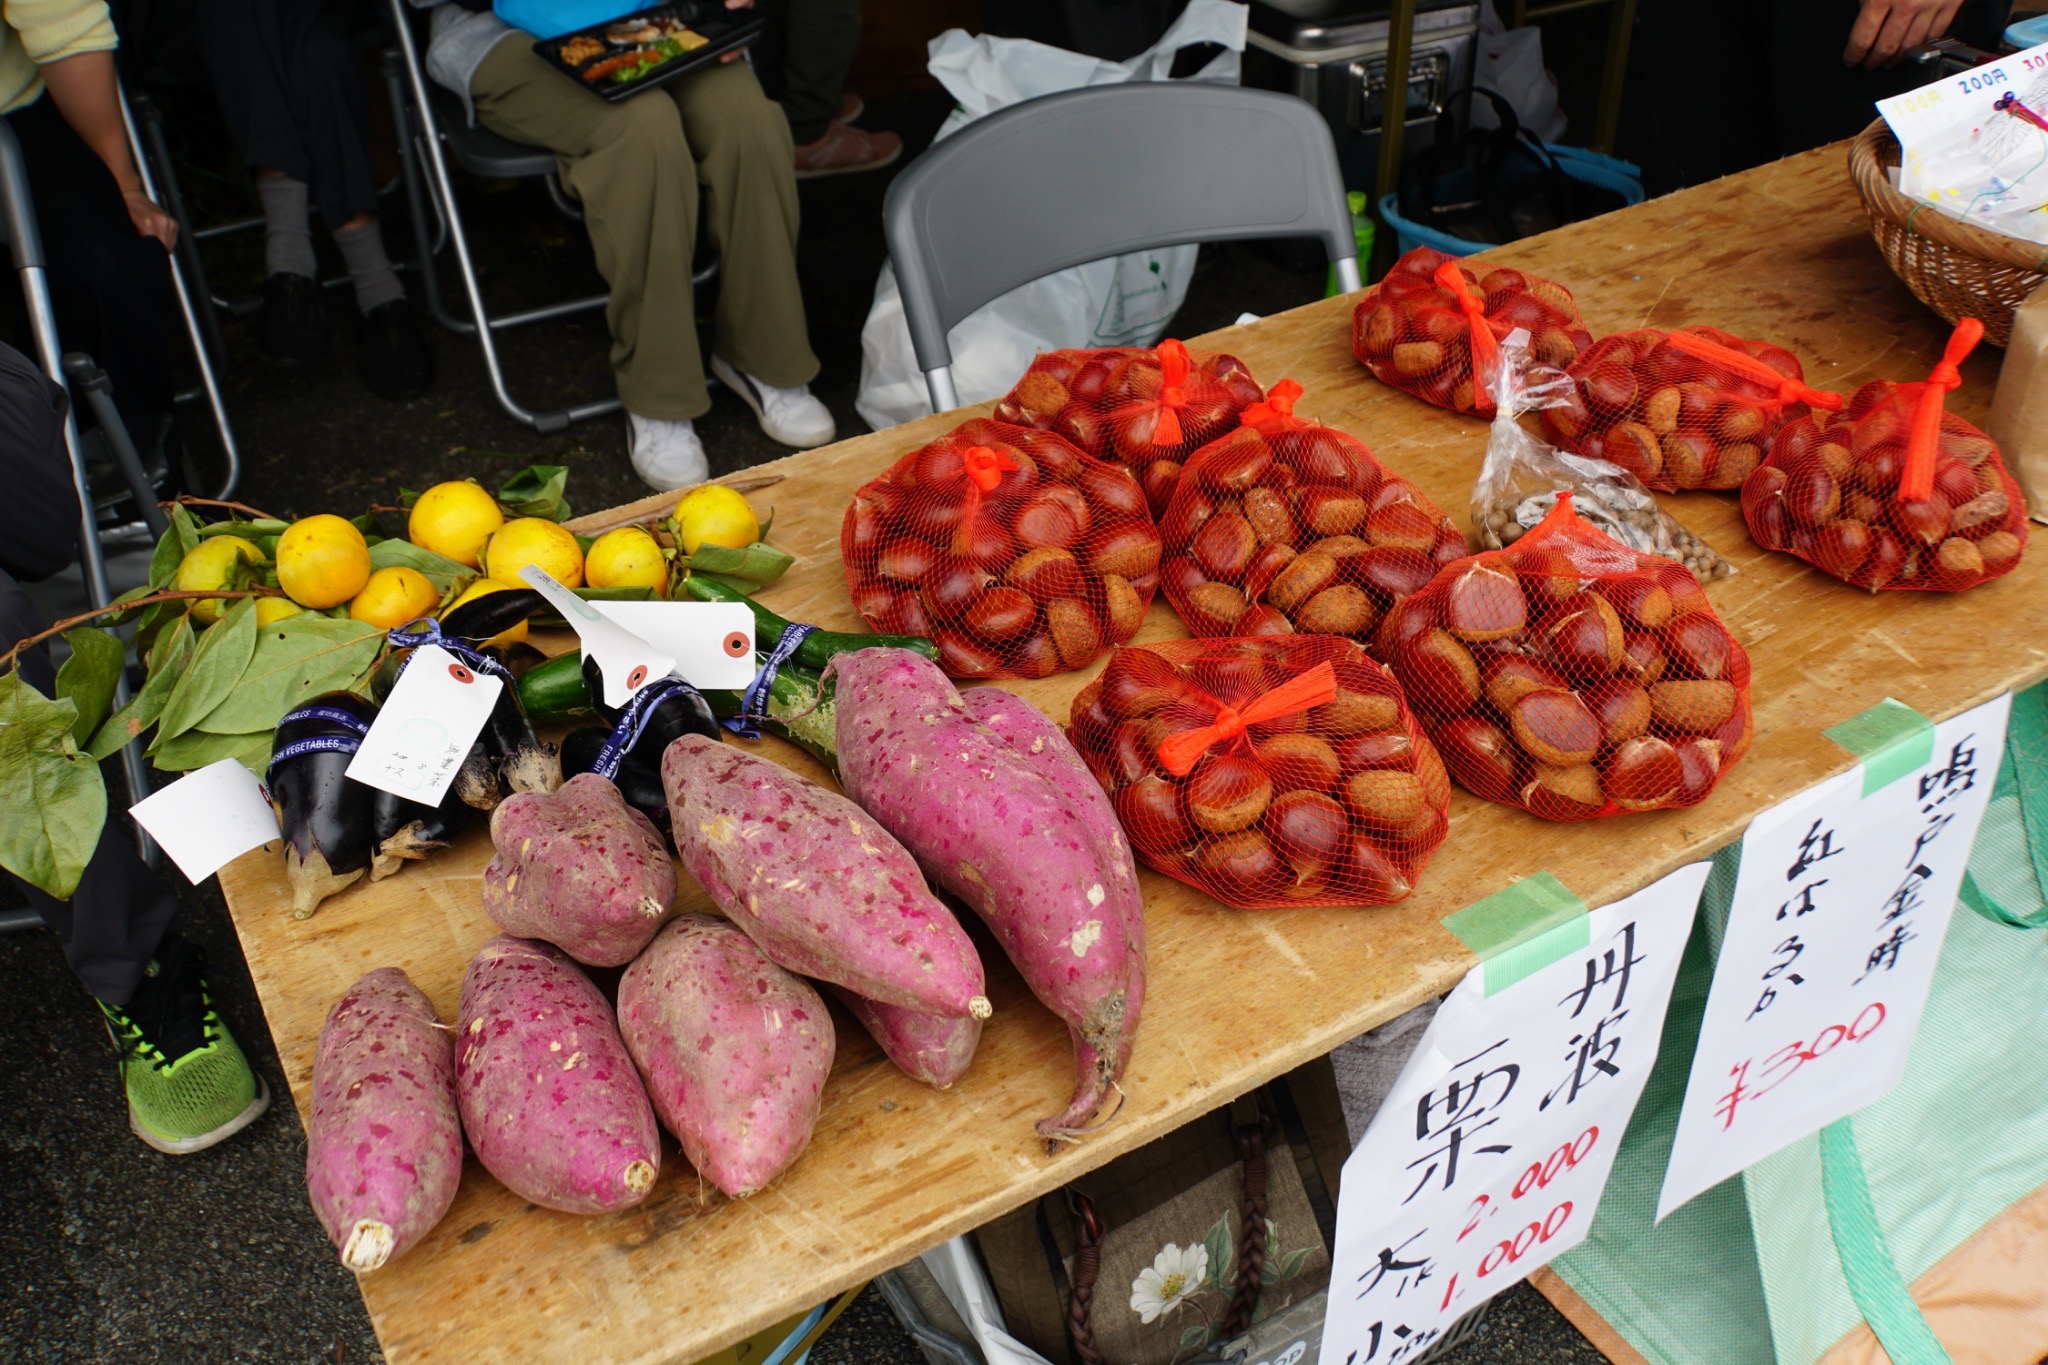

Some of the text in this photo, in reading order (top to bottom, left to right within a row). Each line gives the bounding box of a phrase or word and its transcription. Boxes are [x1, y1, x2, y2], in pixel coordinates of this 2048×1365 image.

[1957, 67, 2009, 96] 200円
[2021, 51, 2048, 73] 30
[286, 739, 340, 756] VEGETABLES
[594, 744, 613, 772] FRESH
[1745, 817, 1845, 1023] 紅はるか
[1538, 921, 1647, 1112] 丹波
[1713, 1001, 1887, 1132] ¥300
[1401, 1037, 1521, 1206] 栗
[1356, 1227, 1432, 1300] 大
